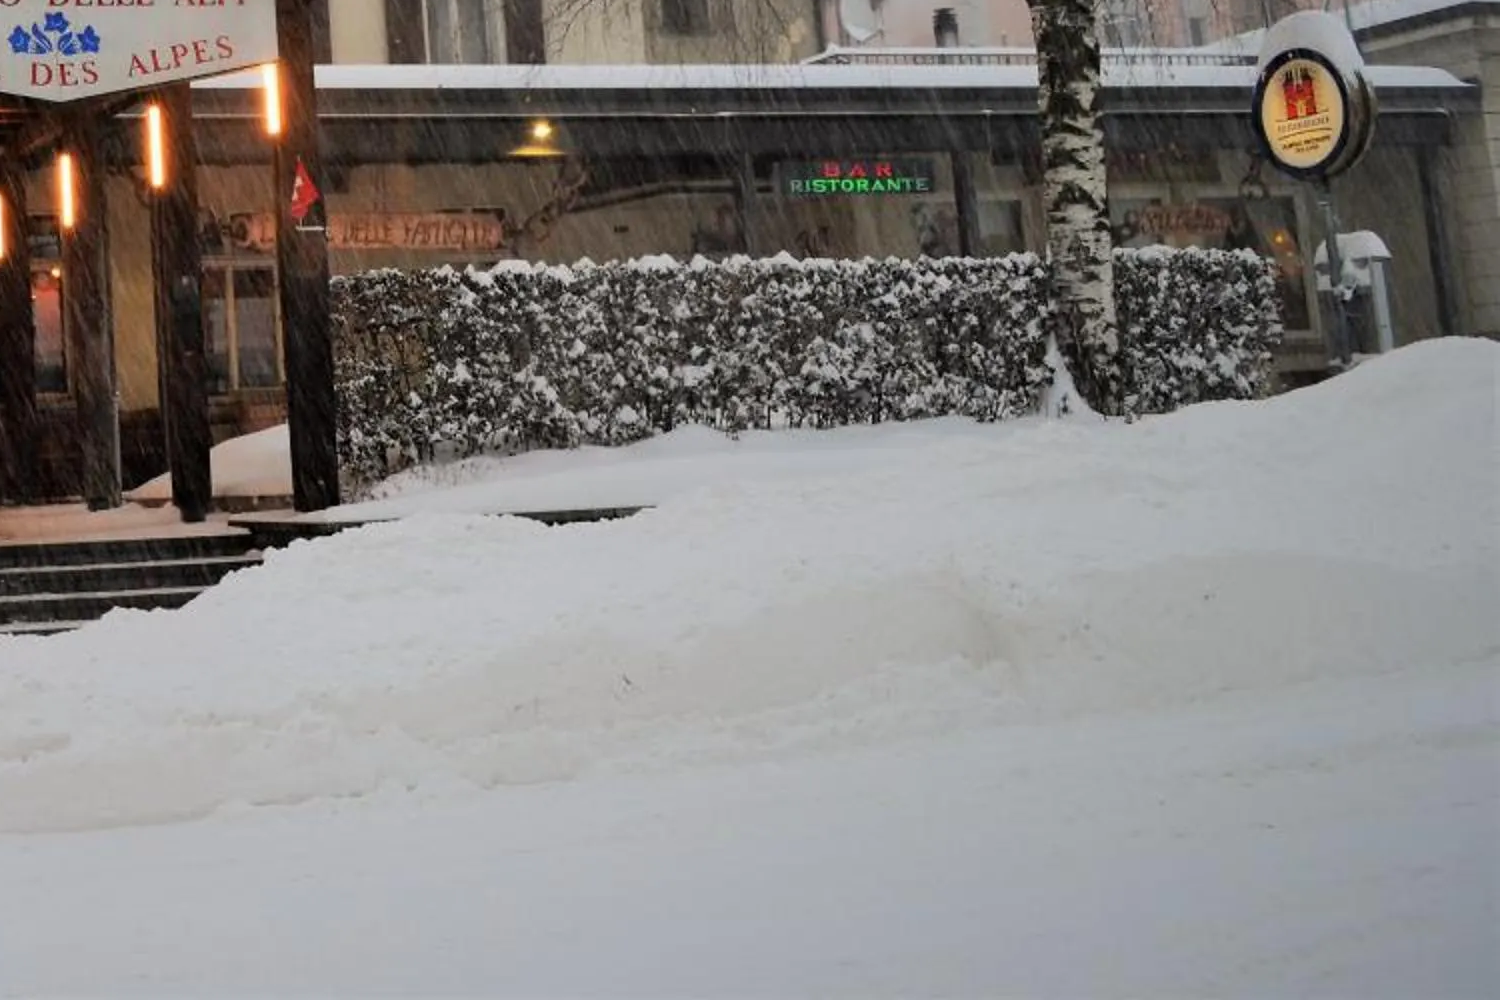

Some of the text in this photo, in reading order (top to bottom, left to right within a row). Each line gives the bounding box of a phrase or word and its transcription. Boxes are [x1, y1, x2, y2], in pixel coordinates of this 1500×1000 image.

[30, 60, 99, 87] DES
[127, 35, 234, 78] ALPES
[822, 162, 893, 177] BAR
[790, 178, 929, 193] RISTORANTE
